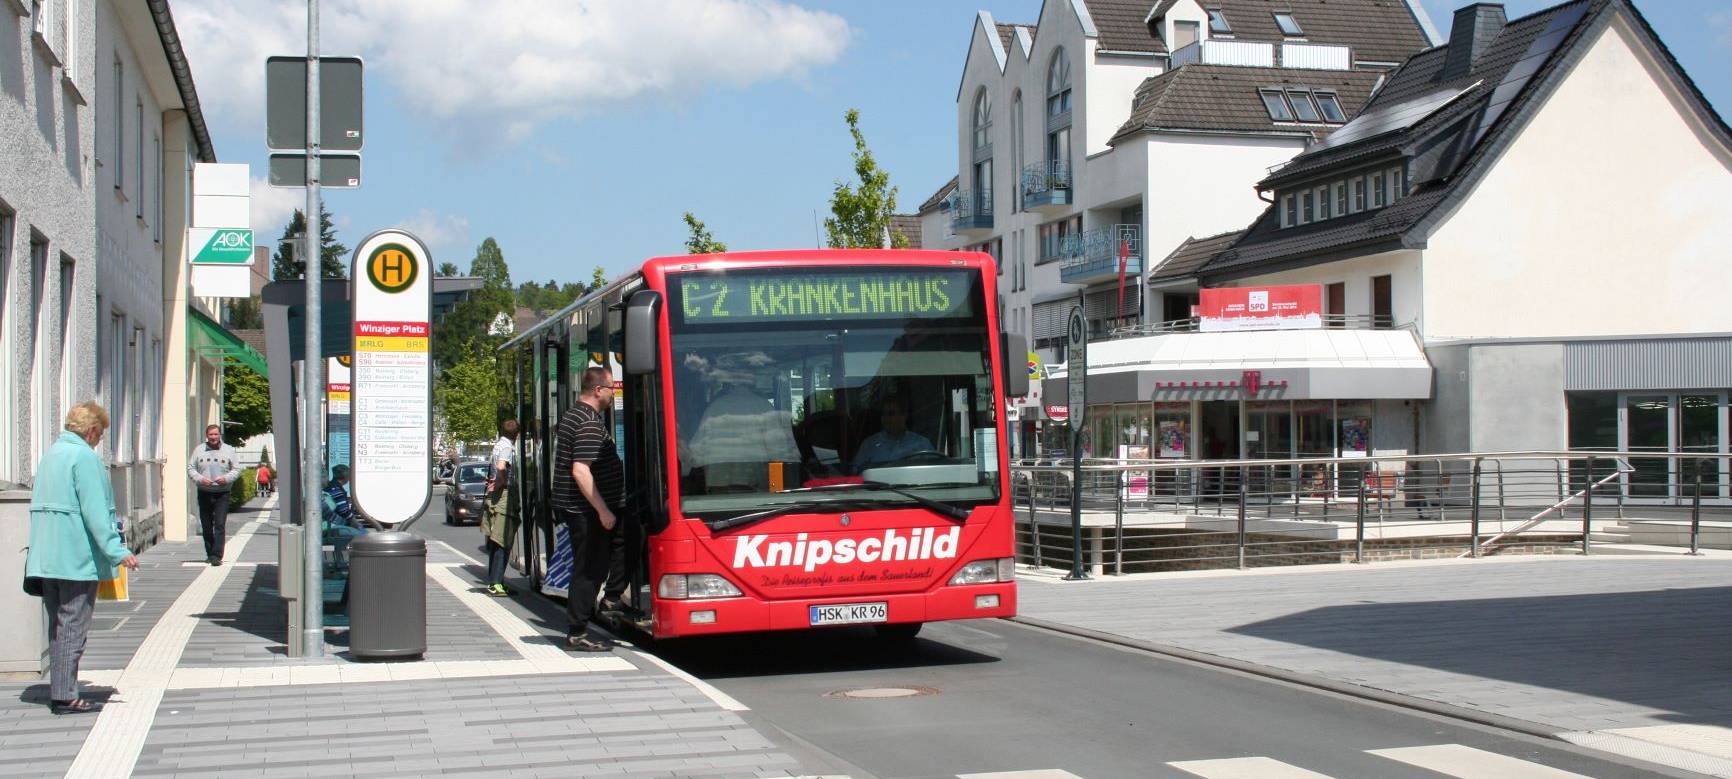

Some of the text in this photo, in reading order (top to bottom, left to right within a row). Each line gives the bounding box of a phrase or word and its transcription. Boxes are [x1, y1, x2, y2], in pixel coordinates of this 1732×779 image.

[212, 232, 250, 247] AOK
[382, 254, 402, 282] H
[683, 277, 950, 317] C 2 KRANKENHAUS
[1250, 303, 1265, 311] SPD
[360, 324, 425, 335] Winziger Platz
[1243, 371, 1261, 395] T
[733, 526, 960, 572] Knipschild
[761, 566, 934, 587] Die Reiseprofis aus dem Sauerland!
[818, 604, 885, 621] HSK KR 96
